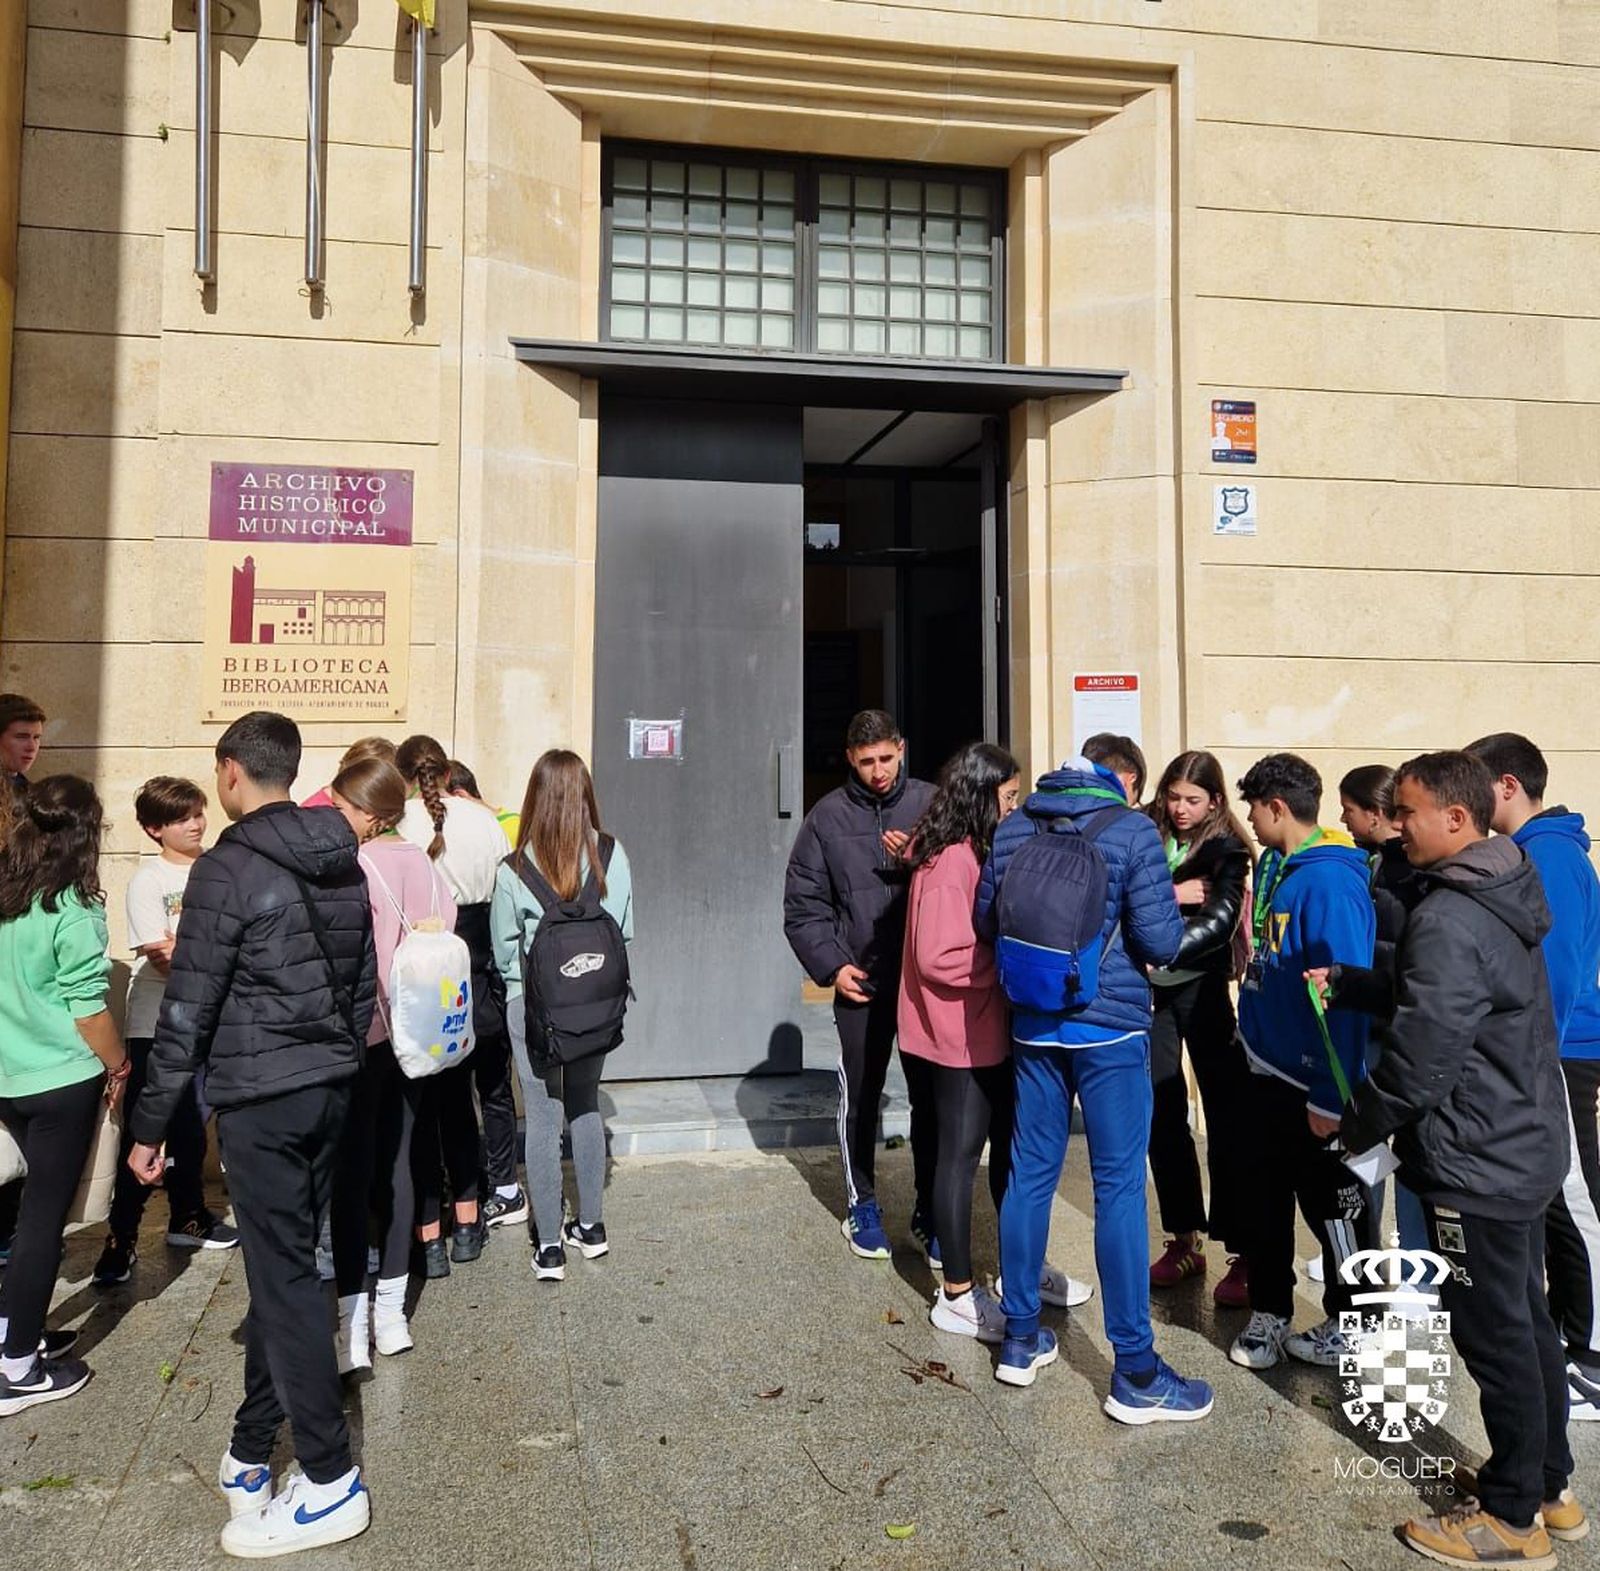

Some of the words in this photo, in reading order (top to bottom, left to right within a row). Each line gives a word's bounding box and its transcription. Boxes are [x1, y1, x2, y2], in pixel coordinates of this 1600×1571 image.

[239, 471, 386, 493] ARCHIVO
[238, 492, 386, 515] HISTÓRICO
[238, 517, 386, 537] MUNICIPAL
[223, 657, 390, 674] BIBLIOTECA
[223, 678, 389, 695] IBEROAMERICANA
[1087, 677, 1125, 686] ARCHIVO
